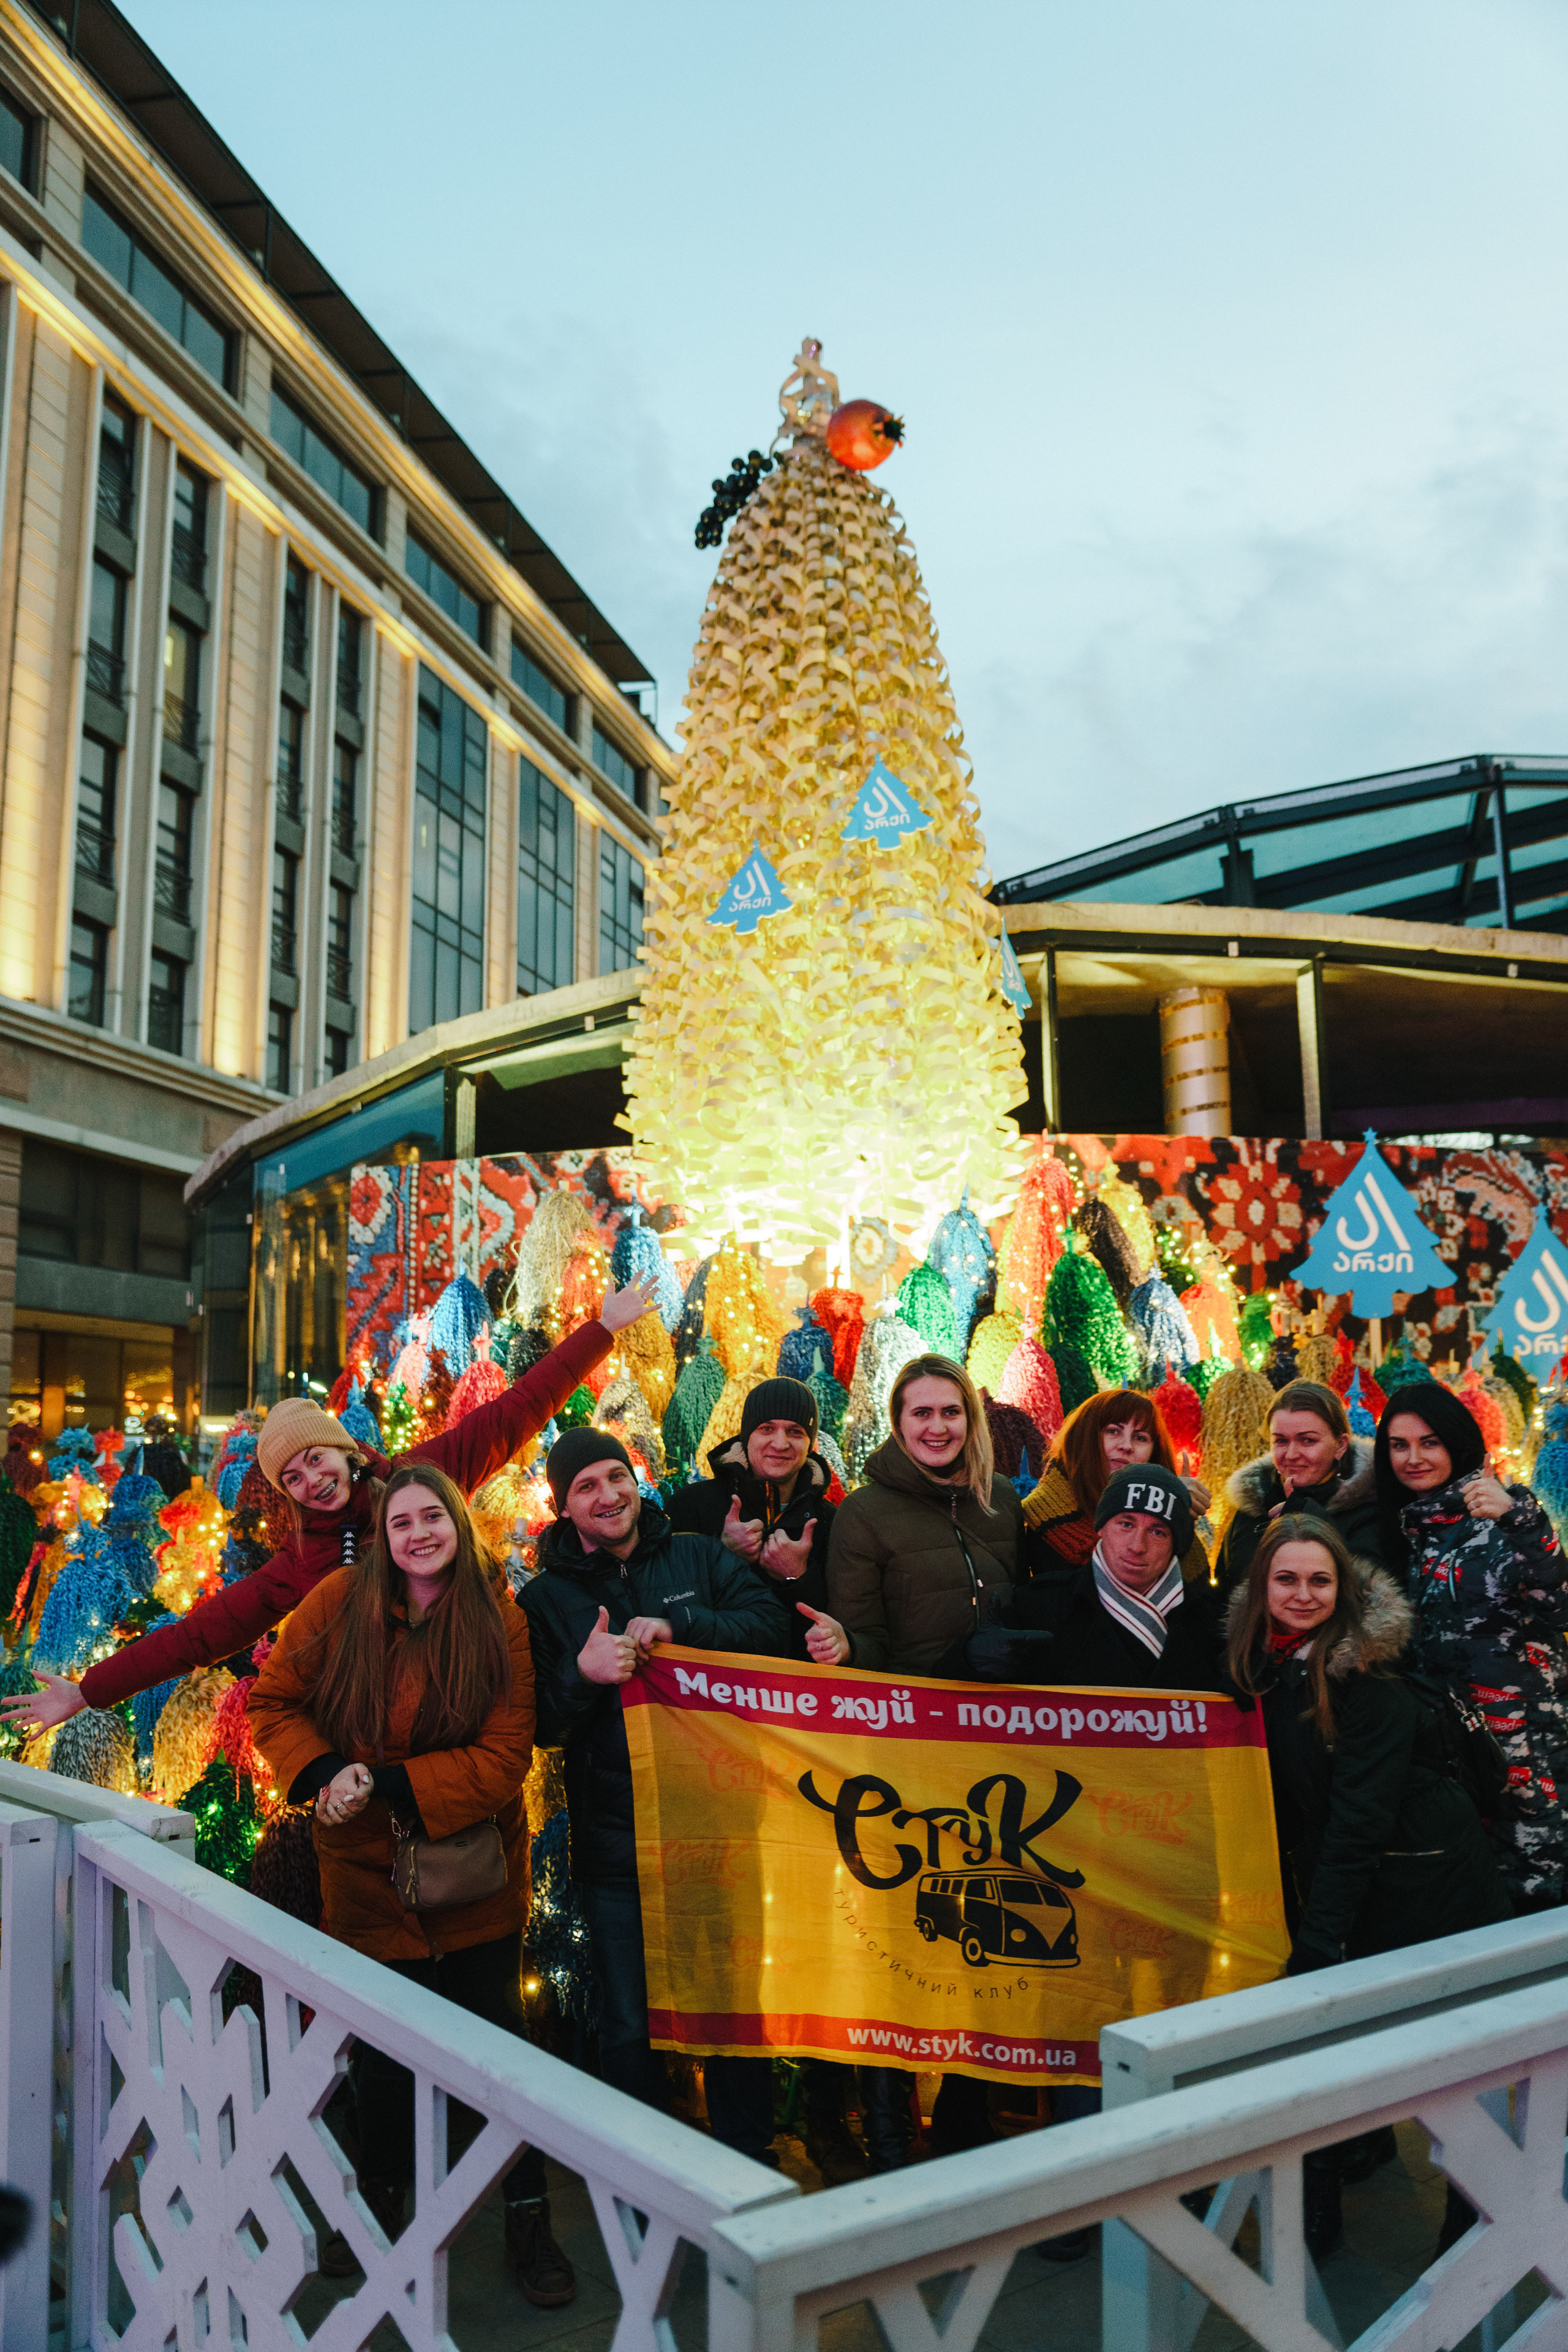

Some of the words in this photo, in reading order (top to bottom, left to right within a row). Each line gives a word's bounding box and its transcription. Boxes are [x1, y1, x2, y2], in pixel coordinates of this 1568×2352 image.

[1333, 1251, 1414, 1273] არქი
[1124, 1483, 1177, 1521] FBI
[673, 1667, 818, 1716] Менше
[831, 1689, 916, 1730] жуй
[957, 1699, 1208, 1741] подорожуй!
[834, 1888, 957, 1996] туристичний
[974, 1977, 1029, 2000] клуб
[846, 2027, 1077, 2067] www.styk.com.ua
